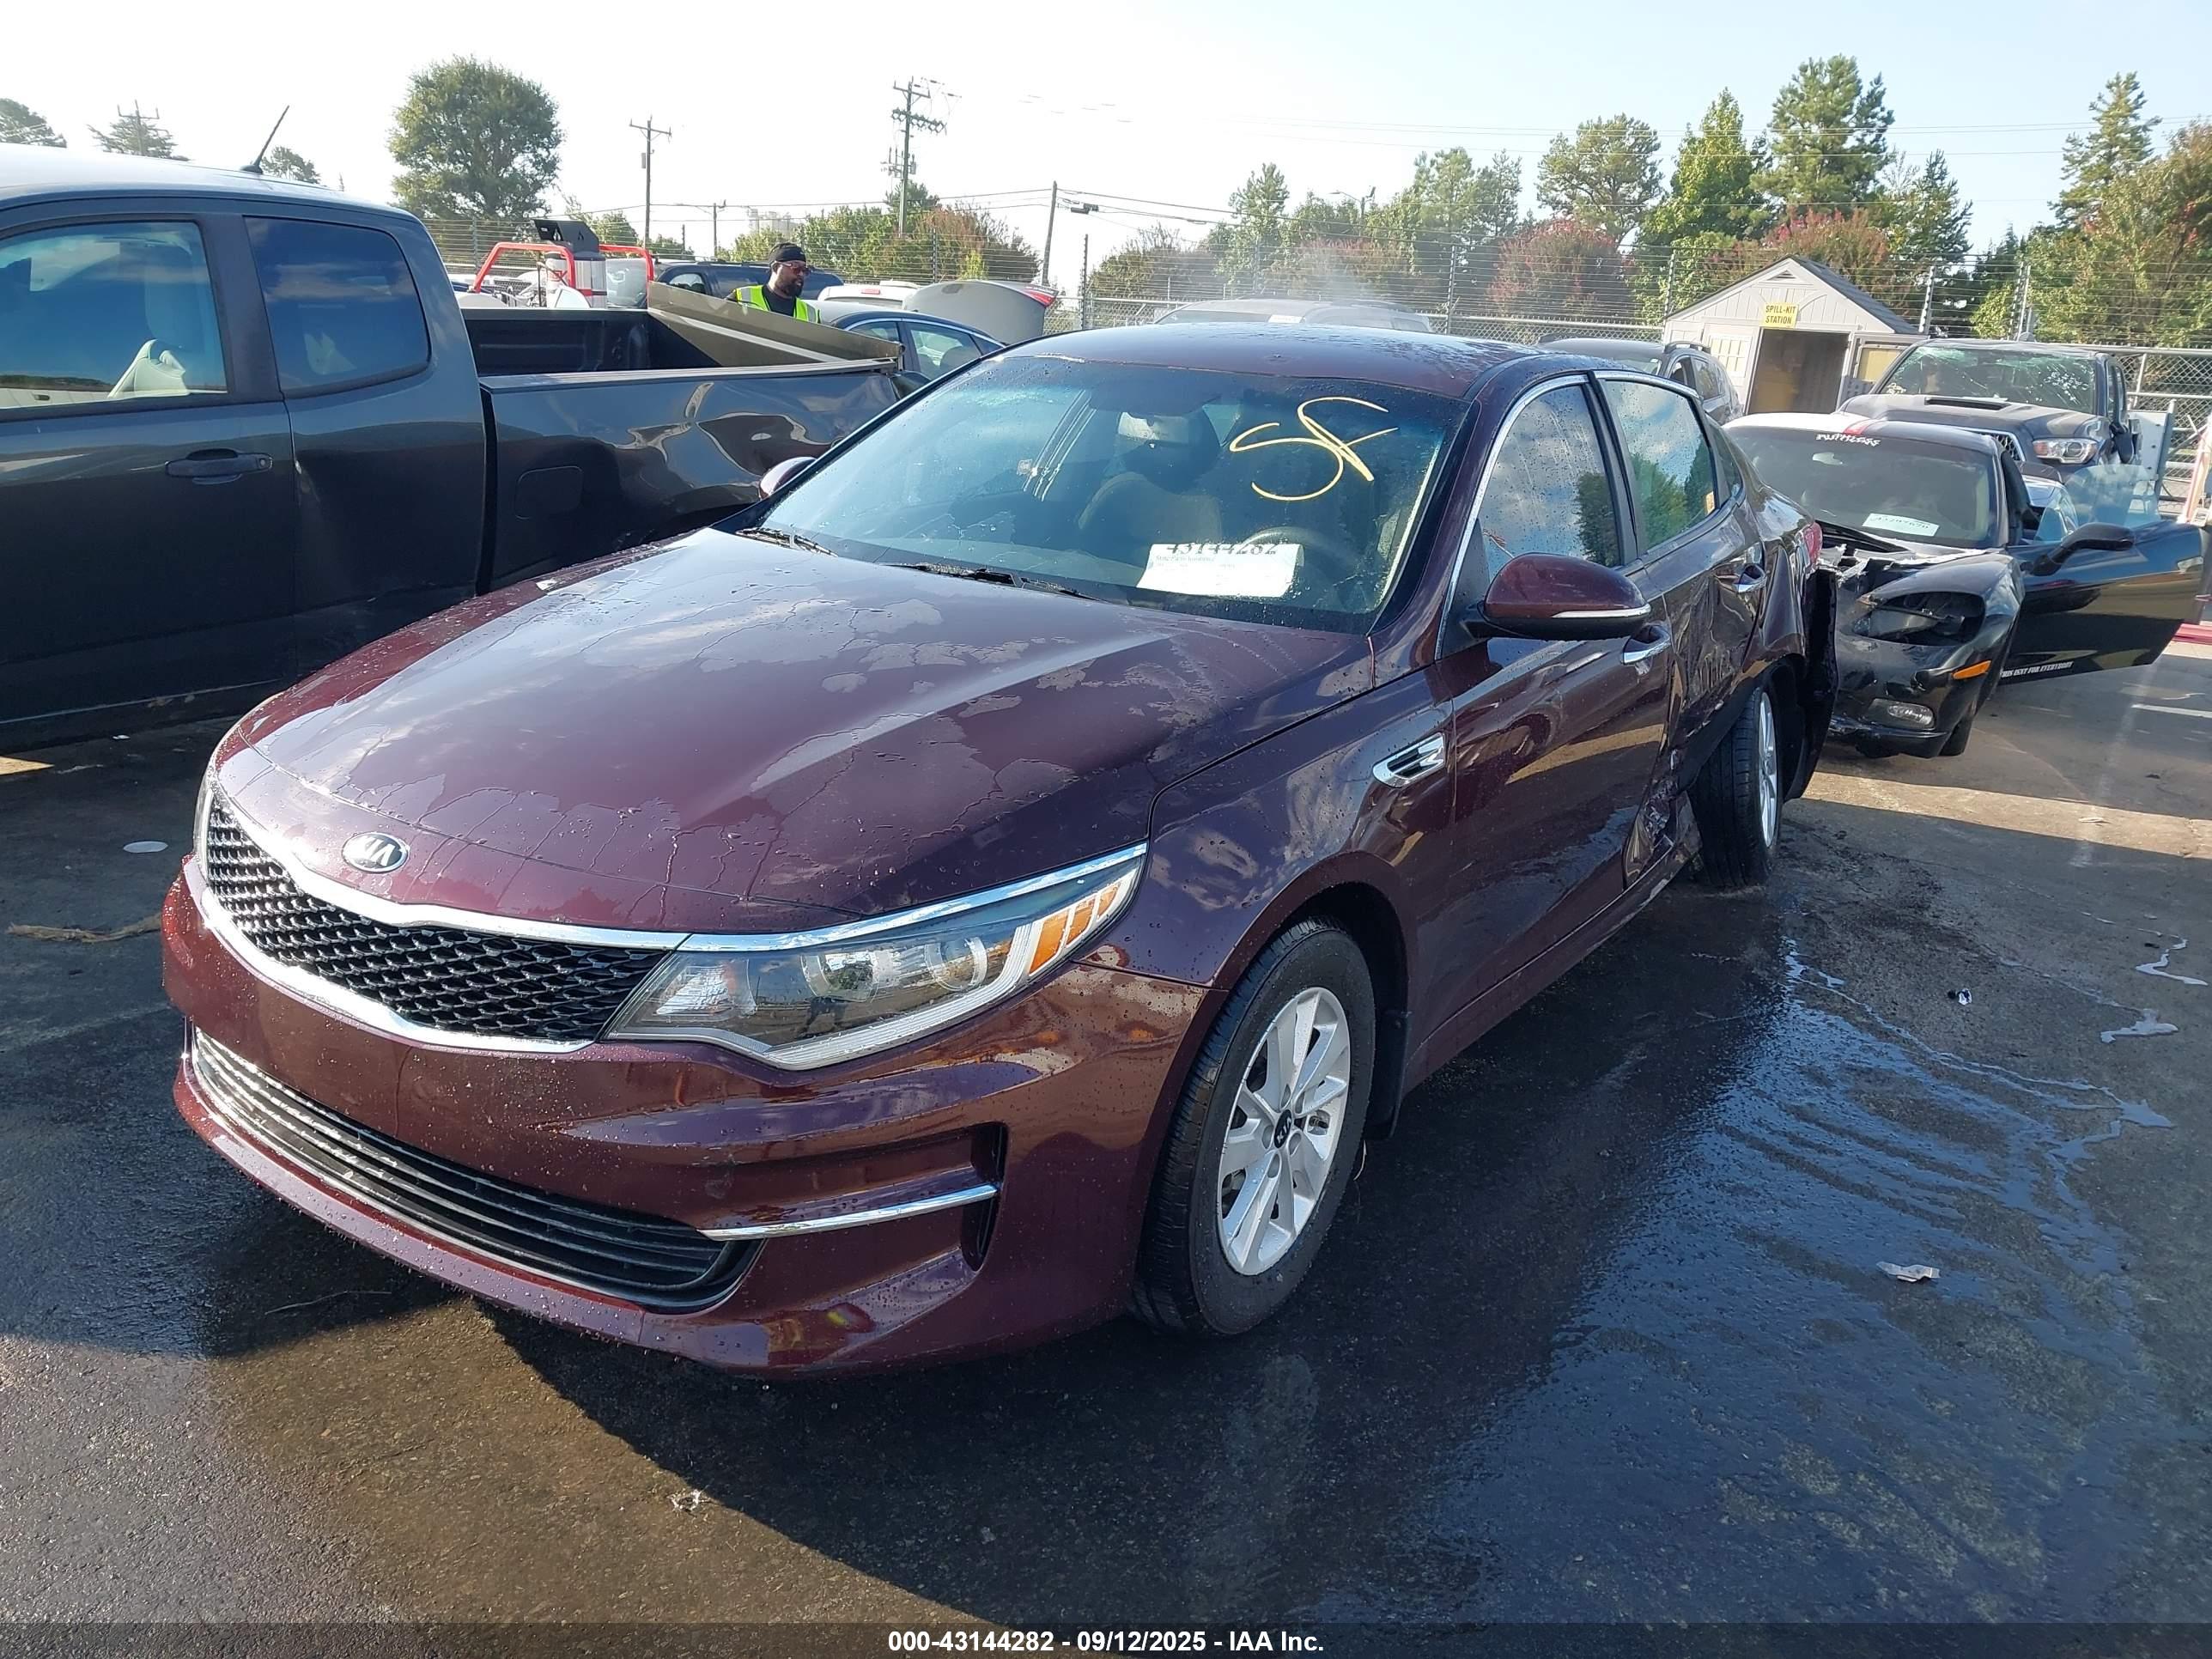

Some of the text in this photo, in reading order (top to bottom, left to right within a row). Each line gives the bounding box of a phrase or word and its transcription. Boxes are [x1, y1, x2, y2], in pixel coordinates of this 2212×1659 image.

[1765, 305, 1796, 314] SPILL-KIT
[1765, 315, 1792, 324] STATION
[1276, 1117, 1291, 1144] KIA
